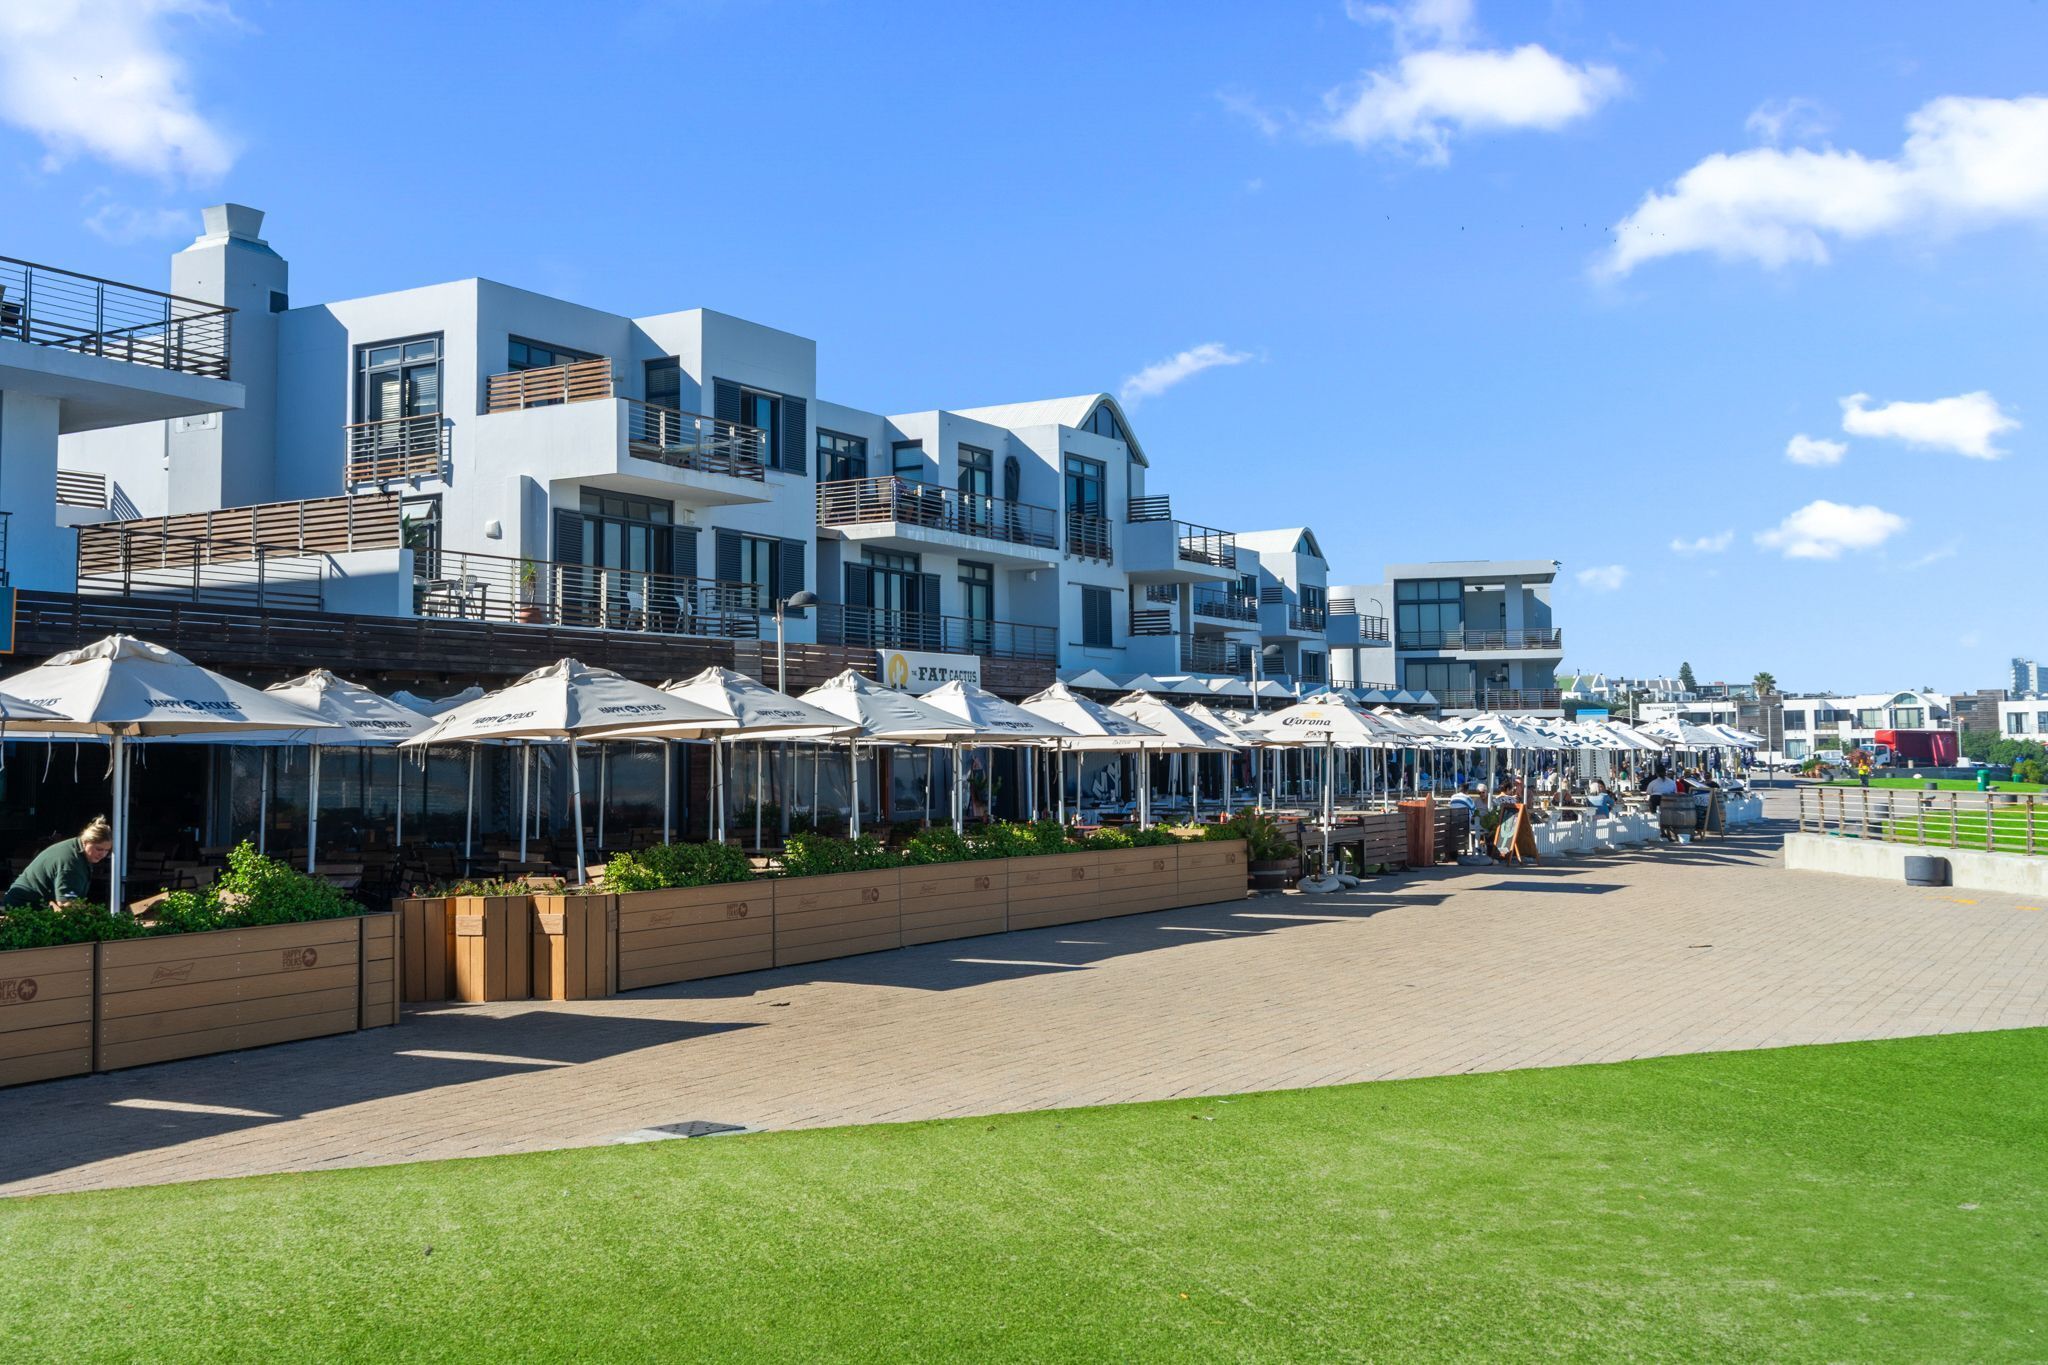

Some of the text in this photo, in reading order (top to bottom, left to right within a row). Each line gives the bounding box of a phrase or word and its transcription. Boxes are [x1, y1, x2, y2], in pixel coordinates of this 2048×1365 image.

[918, 666, 947, 681] FAT
[949, 669, 976, 682] CACTUS
[143, 699, 242, 710] HAPPY FOLKS
[596, 705, 626, 714] HAPPY
[636, 703, 667, 711] FOLKS
[471, 715, 500, 725] HAPPY
[508, 710, 537, 720] FOLKS
[1282, 716, 1332, 727] Corona
[345, 720, 412, 728] HAPPY FOLKS
[281, 957, 302, 968] FOLKS
